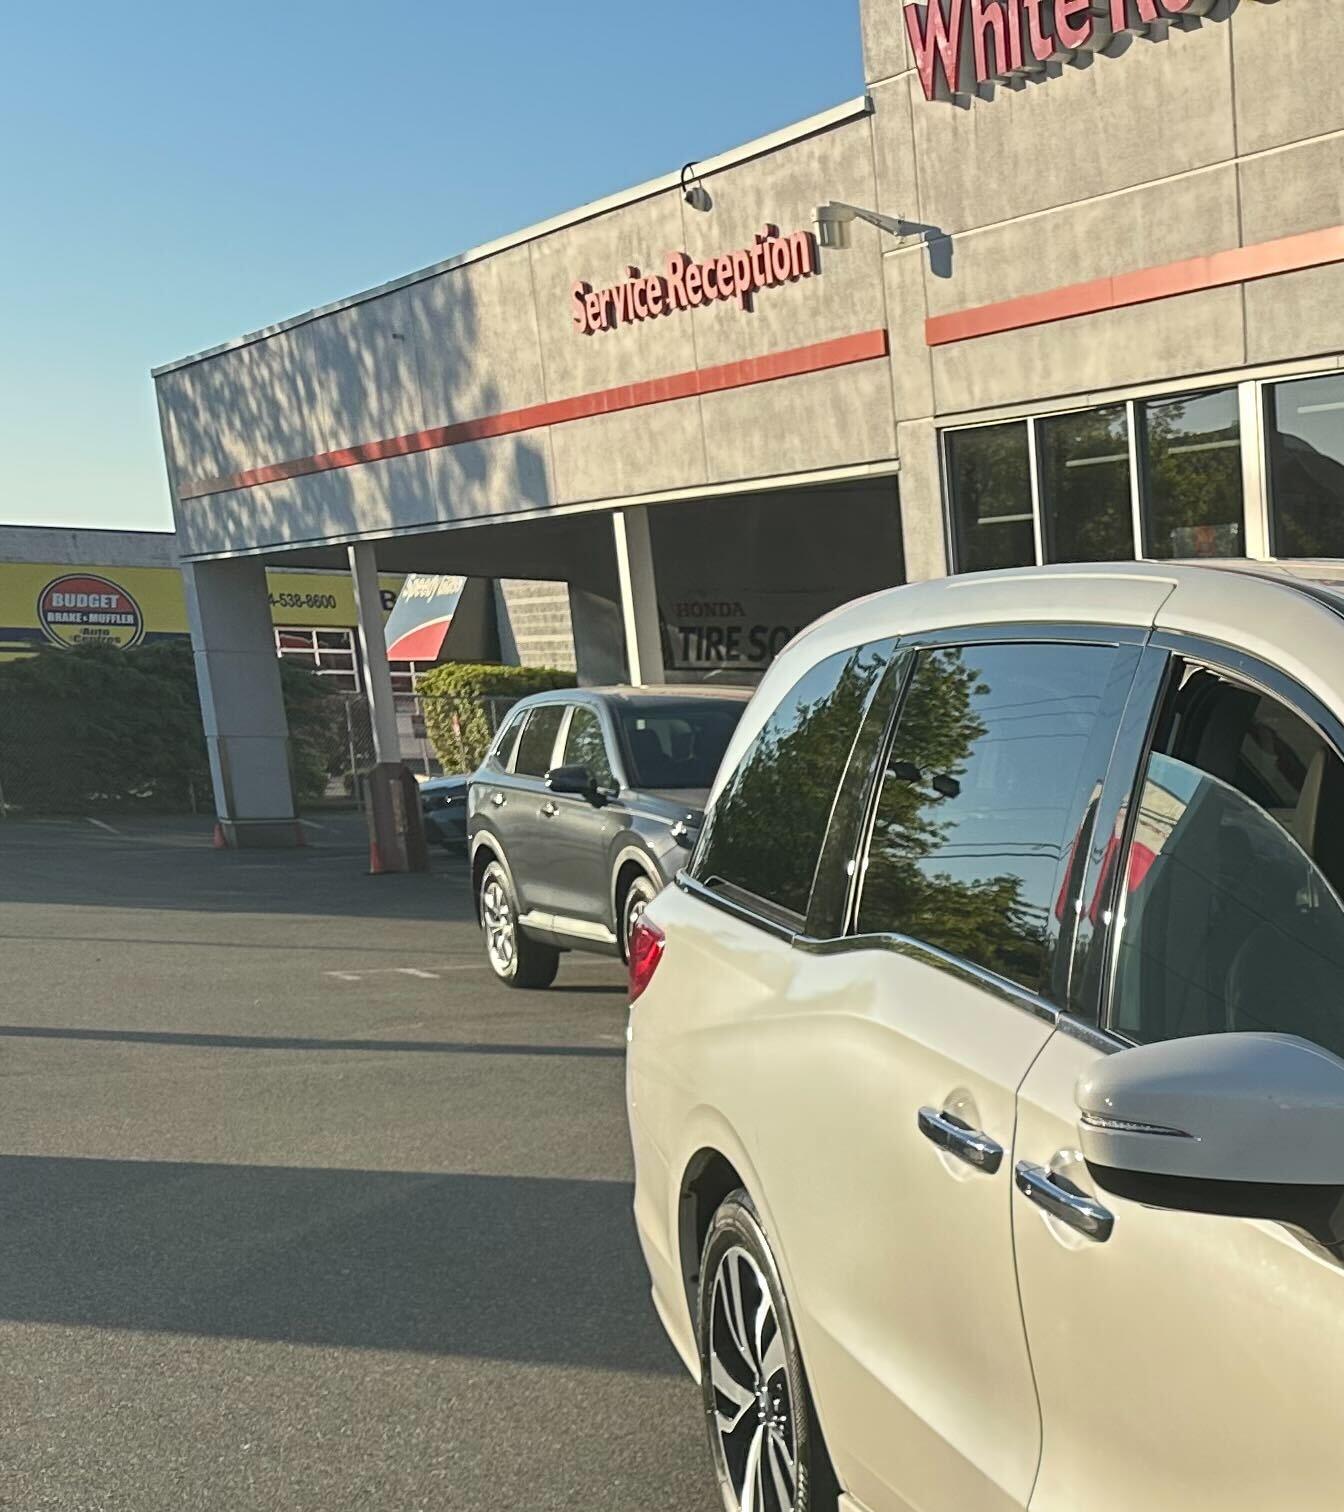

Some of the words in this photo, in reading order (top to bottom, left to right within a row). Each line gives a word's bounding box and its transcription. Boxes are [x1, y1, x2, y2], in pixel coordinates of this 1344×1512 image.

[903, 0, 1094, 101] White
[572, 264, 664, 335] Service
[664, 222, 812, 312] Reception
[52, 592, 120, 609] BUDGET
[675, 601, 746, 618] HONDA
[47, 611, 82, 623] BRAKE
[88, 613, 134, 624] MUFFLER
[678, 625, 743, 662] TIRE
